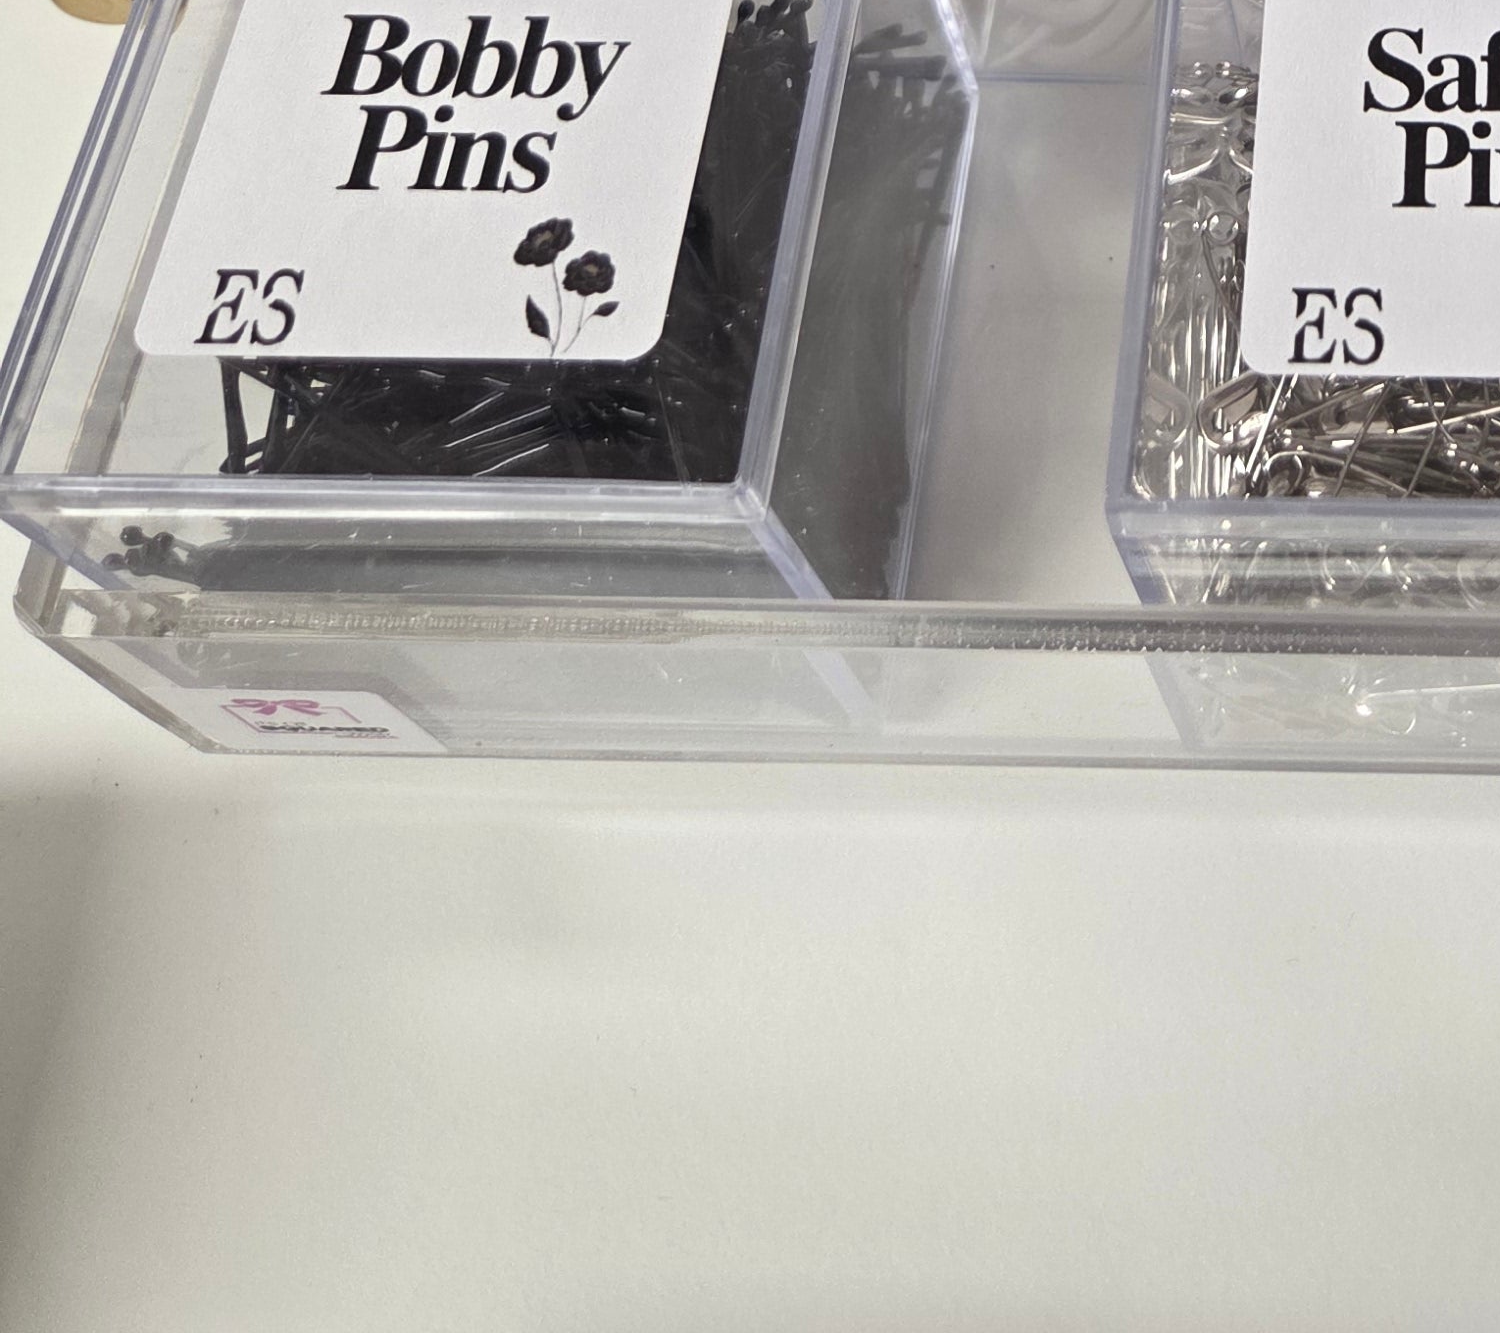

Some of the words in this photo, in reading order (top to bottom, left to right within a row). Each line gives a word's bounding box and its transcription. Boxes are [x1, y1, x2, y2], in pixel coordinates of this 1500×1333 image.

[320, 13, 632, 121] Bobby
[335, 104, 558, 194] Pins
[193, 268, 305, 347] ES
[1287, 286, 1385, 366] ES
